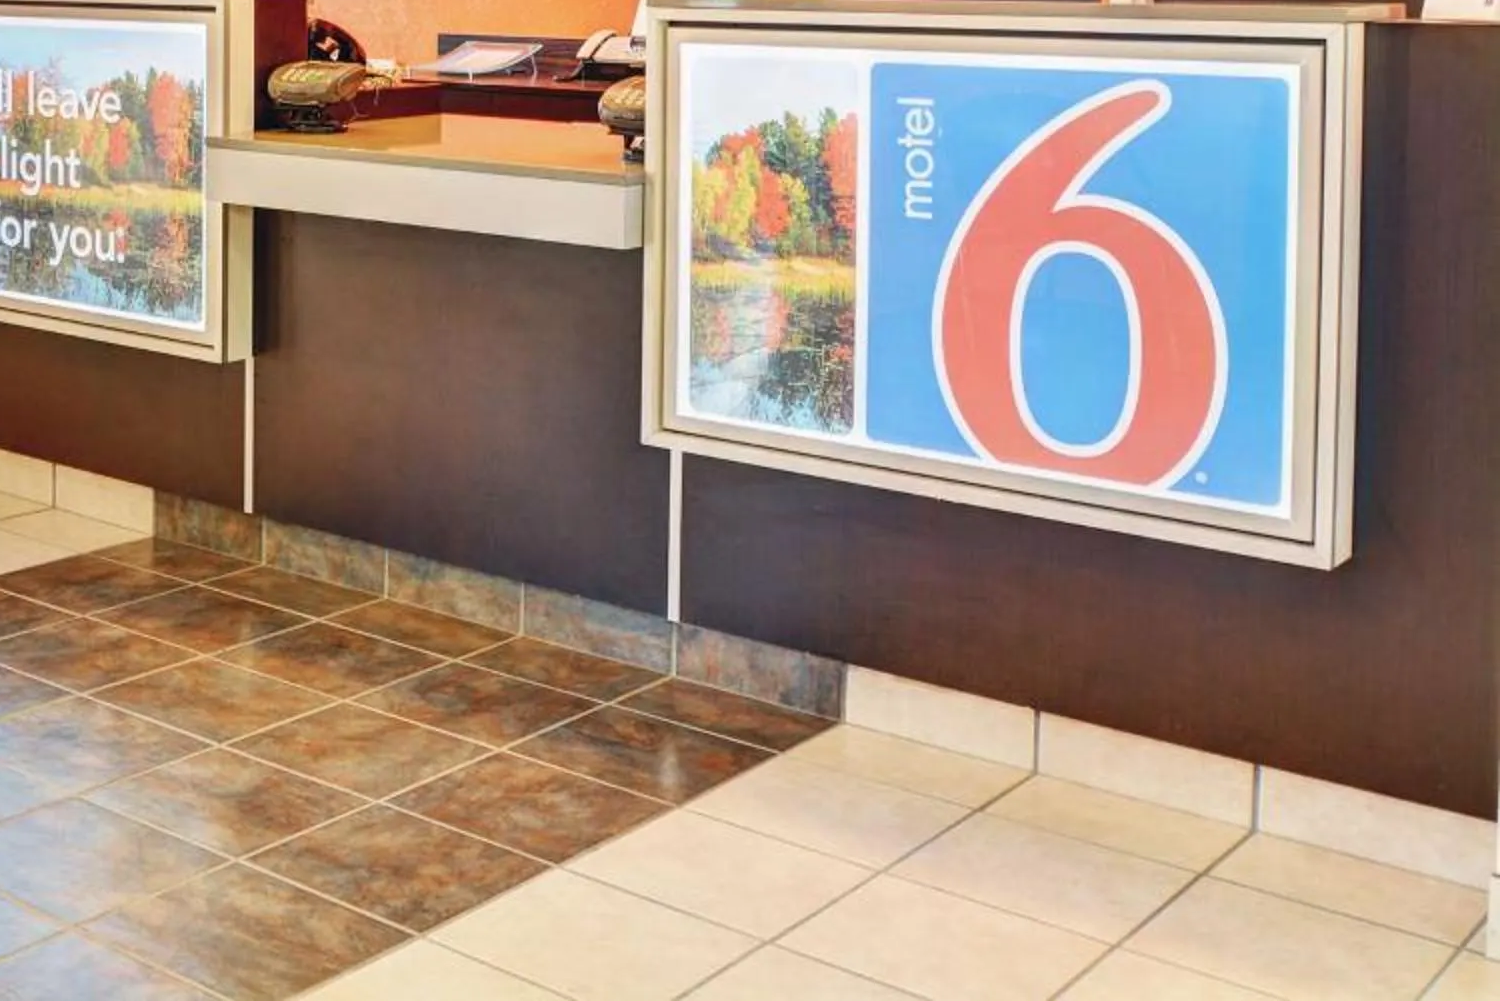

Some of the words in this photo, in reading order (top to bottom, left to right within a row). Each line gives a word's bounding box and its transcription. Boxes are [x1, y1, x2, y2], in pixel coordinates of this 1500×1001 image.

[27, 70, 123, 124] leave
[0, 135, 82, 196] light
[896, 97, 935, 220] motel
[931, 79, 1229, 490] 6
